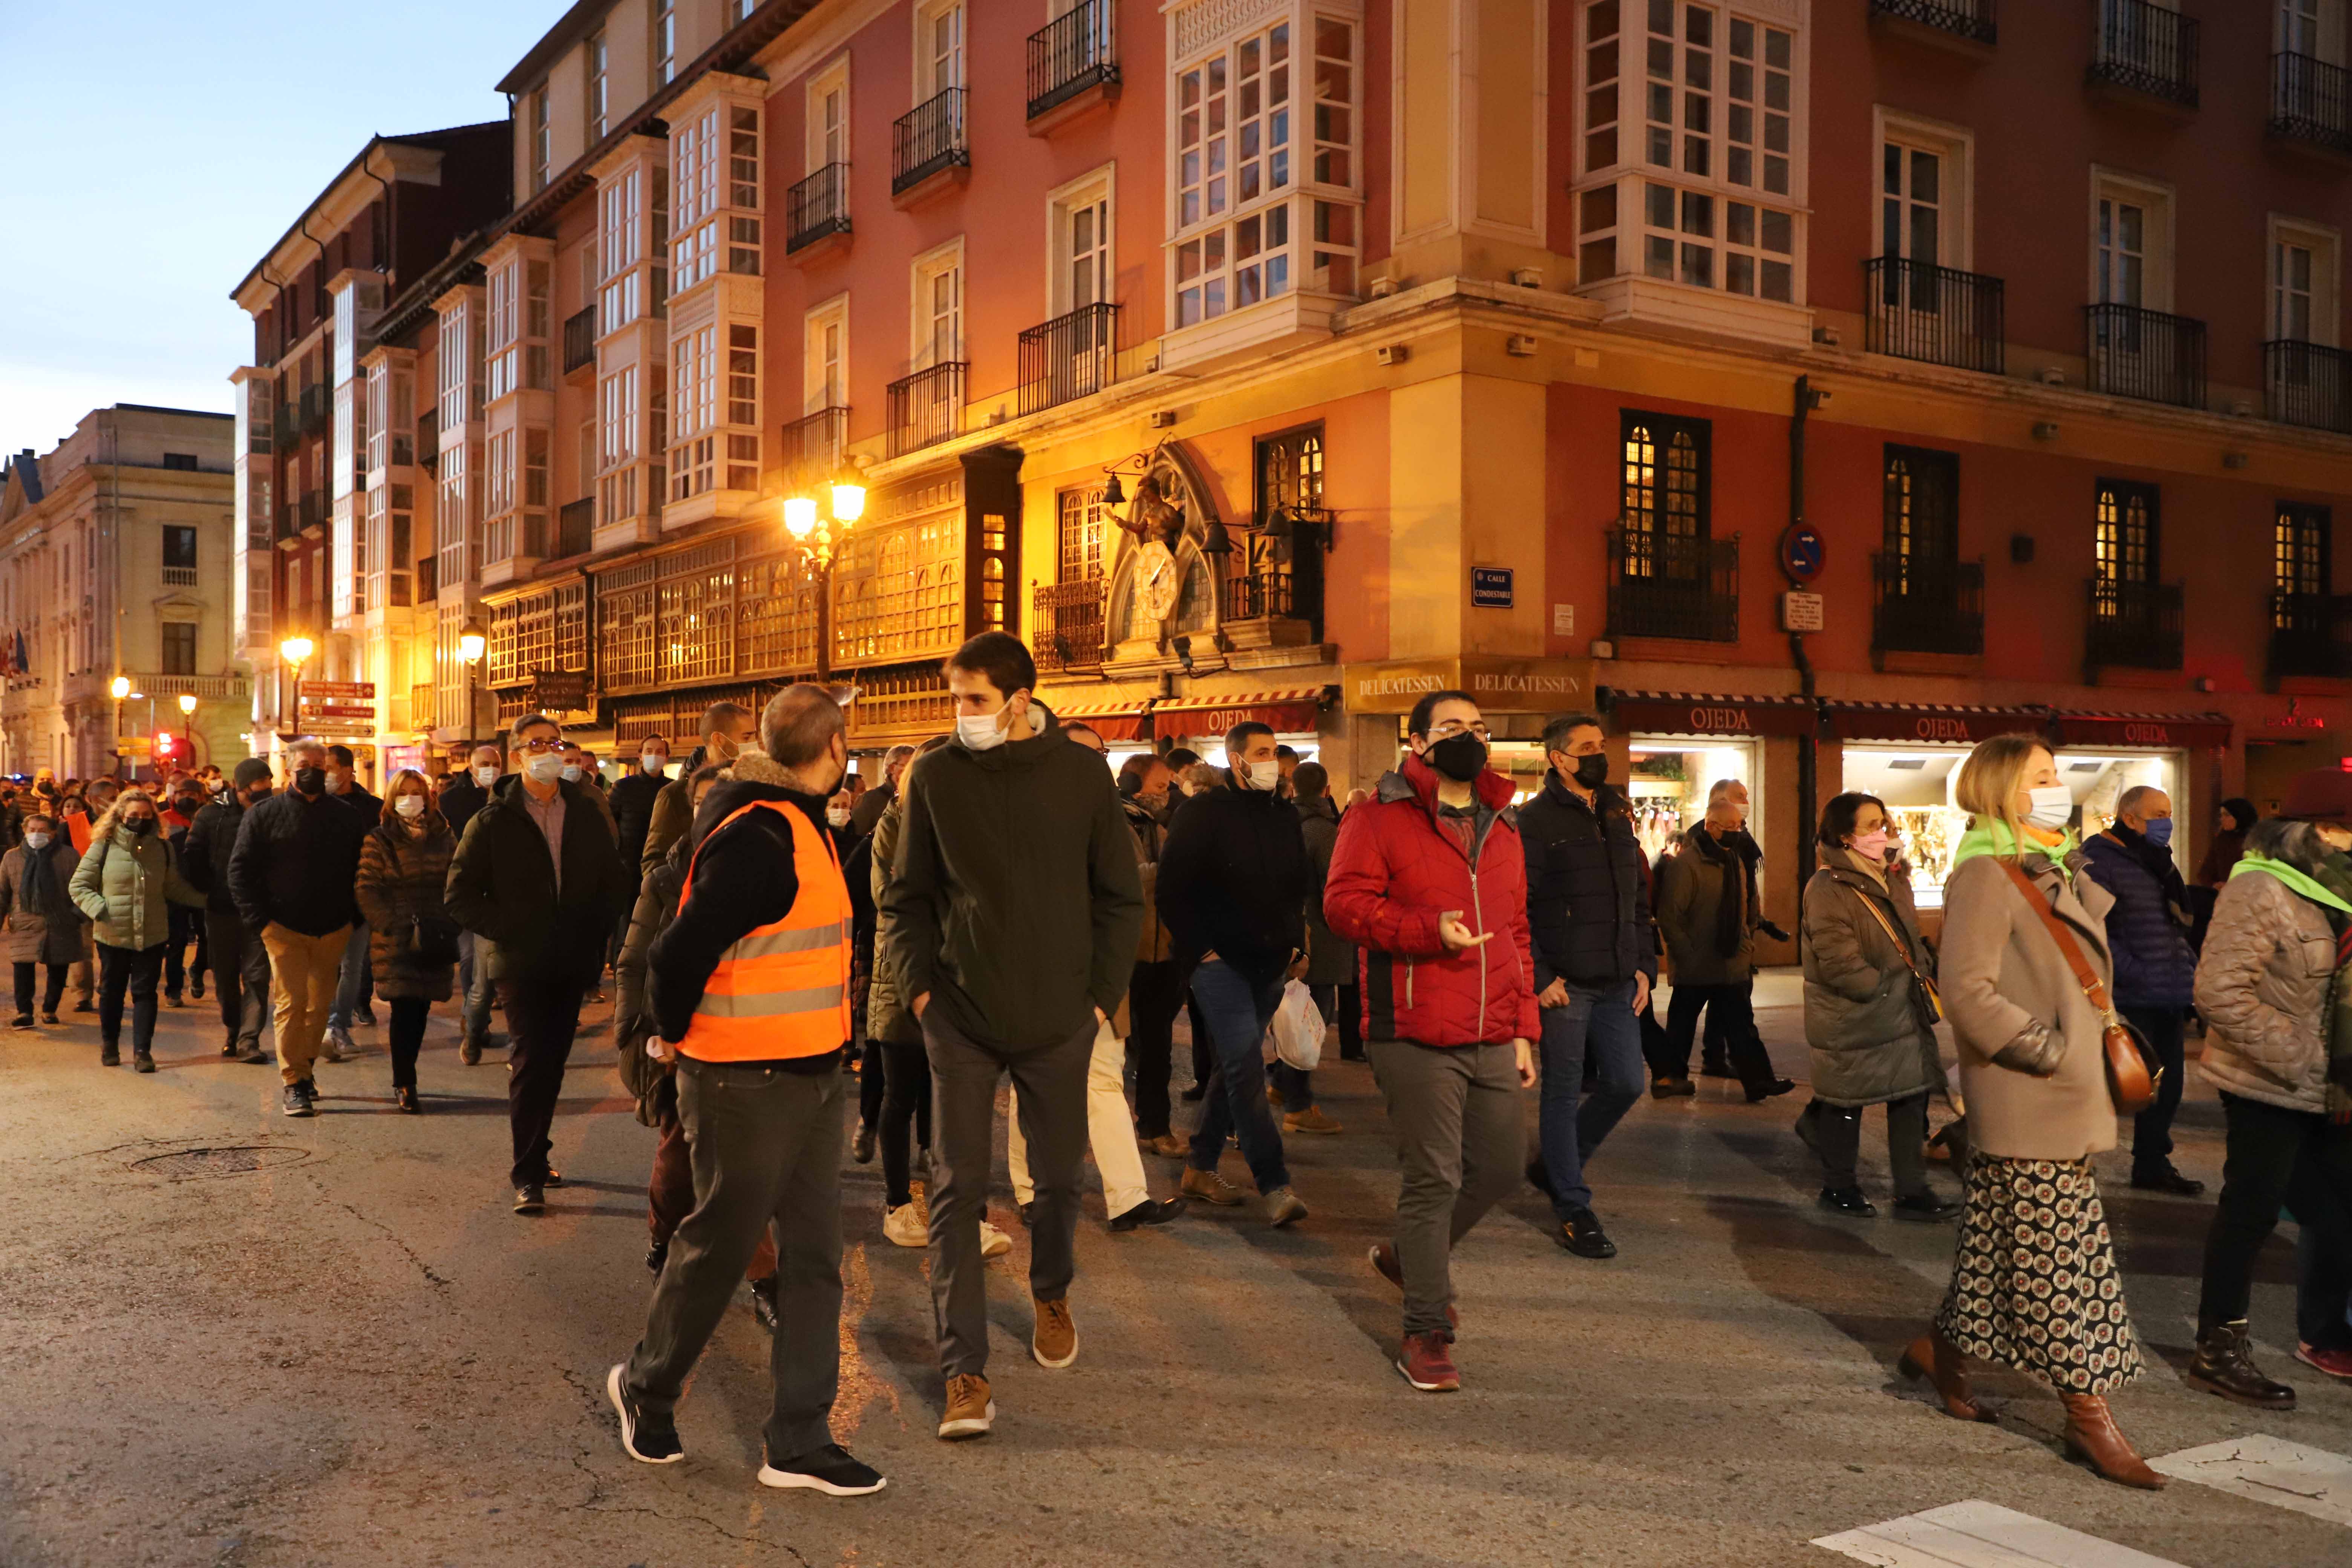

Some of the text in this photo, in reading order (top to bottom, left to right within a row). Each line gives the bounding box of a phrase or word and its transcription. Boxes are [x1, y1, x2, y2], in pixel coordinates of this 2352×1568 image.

[1475, 590, 1511, 599] CONDESTABLE
[1360, 674, 1444, 695] DELICATESSEN
[1475, 674, 1579, 693] DELICATESSEN
[1208, 709, 1253, 730] OJEDA
[1690, 707, 1751, 729] OJEDA
[1917, 718, 1968, 738] OJEDA
[2125, 723, 2169, 742] OJEDA
